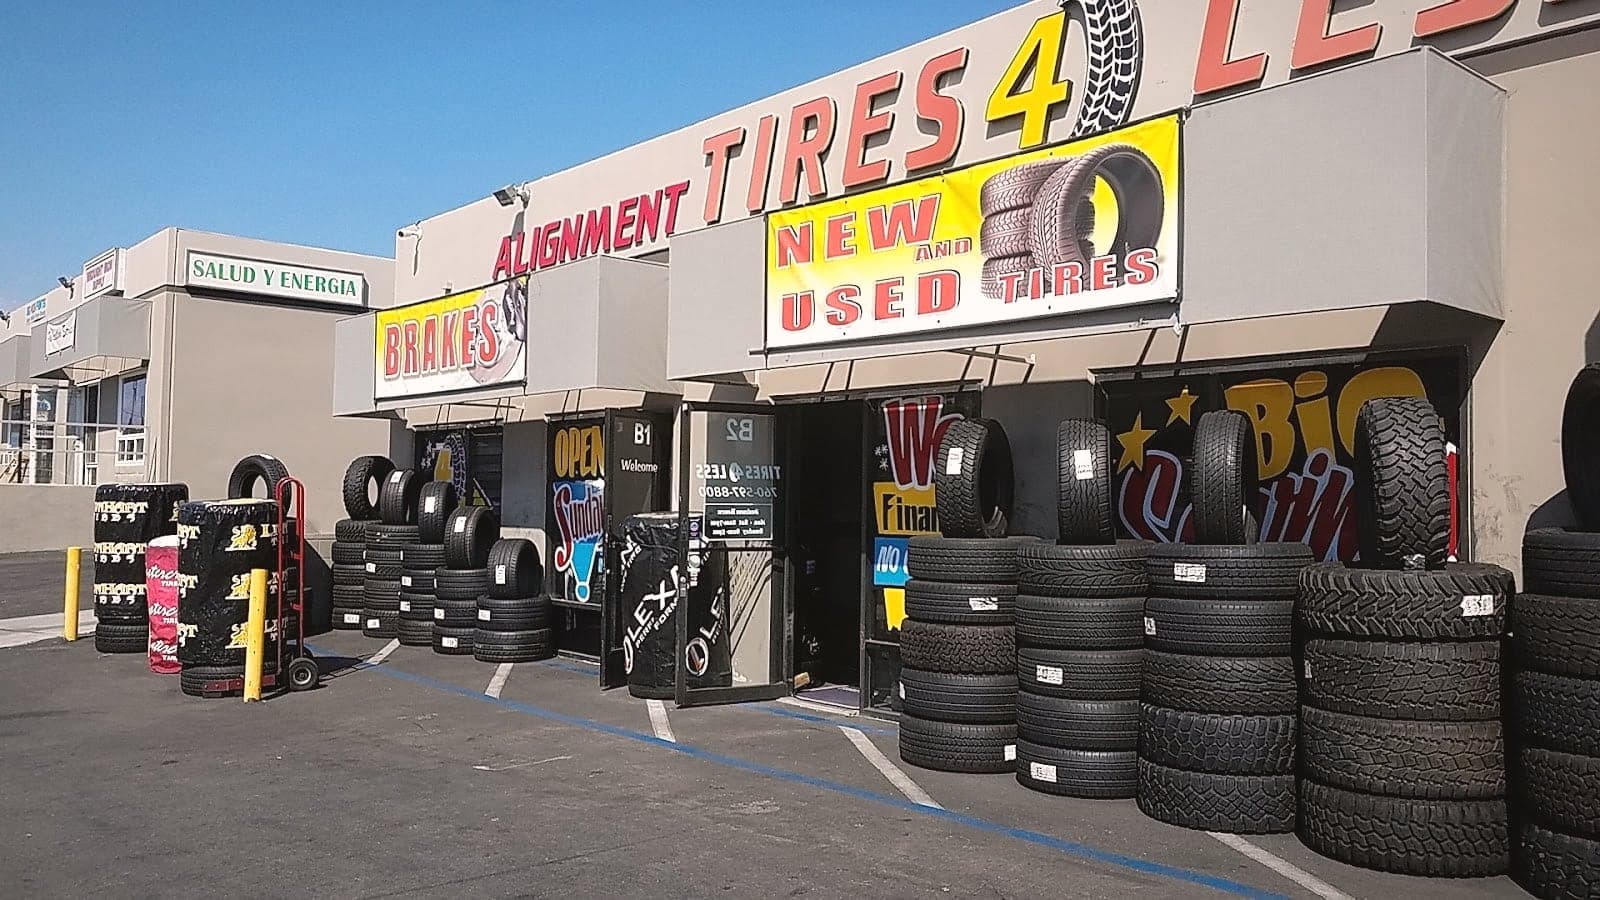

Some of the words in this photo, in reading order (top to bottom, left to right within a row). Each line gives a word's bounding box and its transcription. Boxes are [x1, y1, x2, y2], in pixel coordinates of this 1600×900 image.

[703, 47, 968, 224] TIRES
[985, 11, 1072, 149] 4
[493, 180, 690, 280] ALIGNMENT
[777, 194, 941, 268] NEW
[914, 237, 972, 263] AND
[193, 259, 256, 283] SALUD
[264, 269, 274, 286] Y
[280, 271, 357, 297] ENERGIA
[781, 270, 961, 332] USED
[998, 247, 1160, 304] TIRES
[384, 302, 499, 379] BRAKES
[555, 425, 605, 478] OPEN
[634, 422, 651, 445] B1
[620, 459, 658, 473] Welcome
[876, 545, 900, 573] NO
